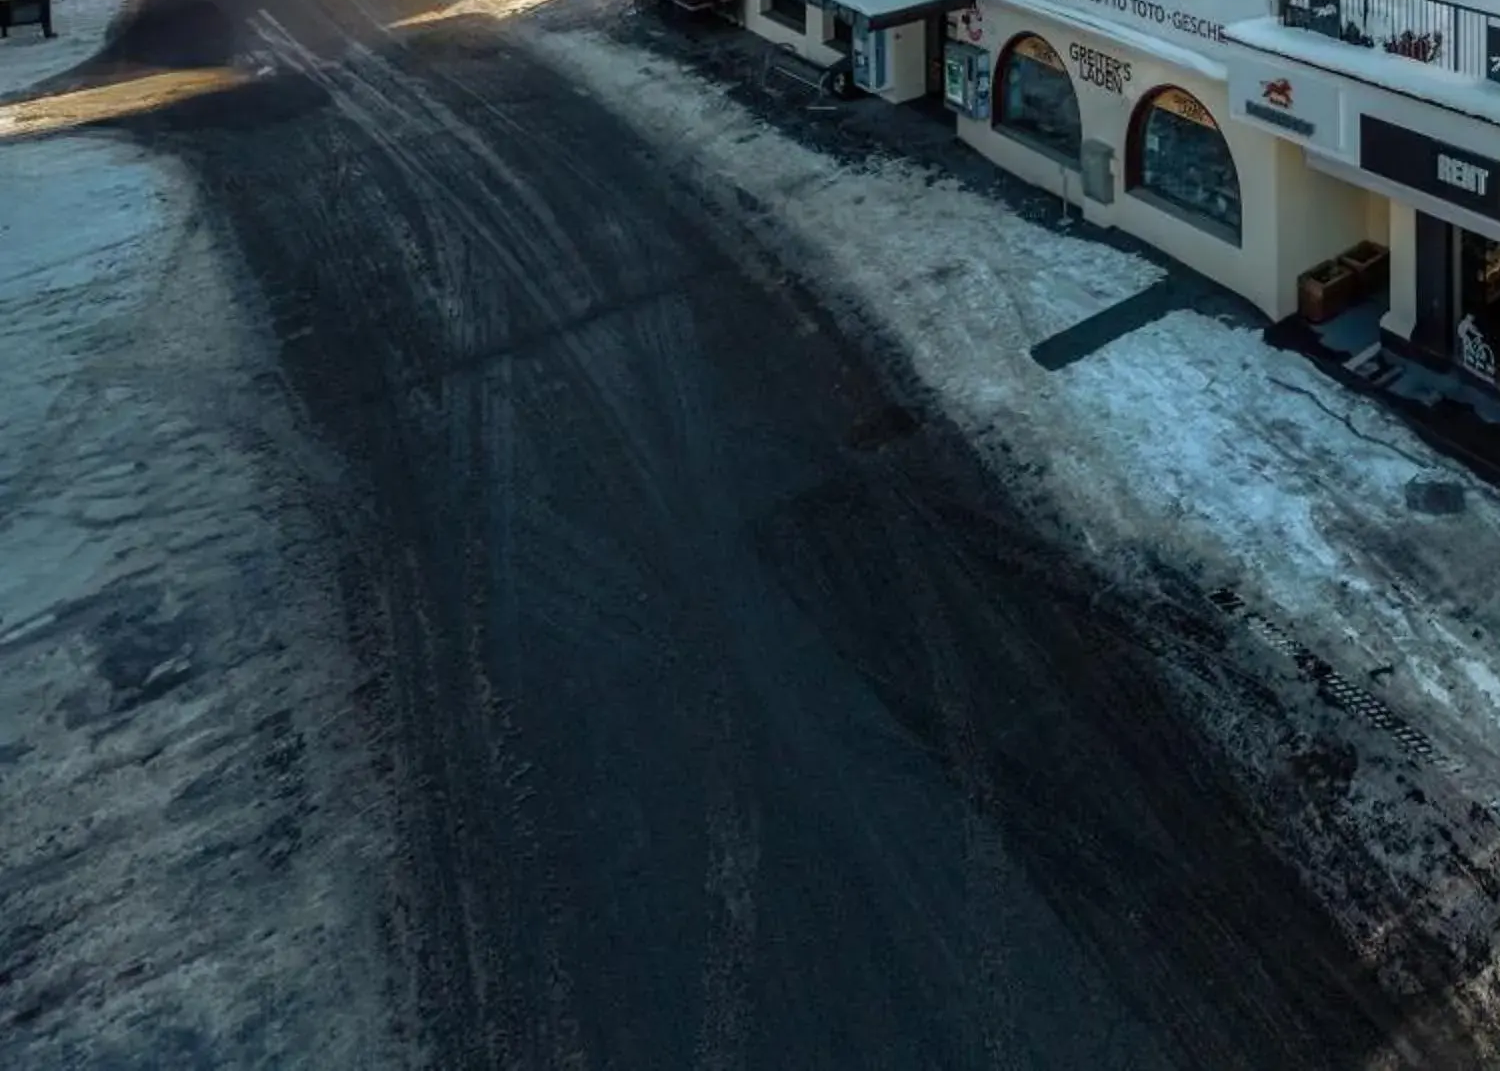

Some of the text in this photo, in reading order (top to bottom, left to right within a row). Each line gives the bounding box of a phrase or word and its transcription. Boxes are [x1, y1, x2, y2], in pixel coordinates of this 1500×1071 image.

[1069, 42, 1132, 81] GREITER'S
[1079, 57, 1124, 94] LADEN
[1438, 153, 1489, 195] RENT
